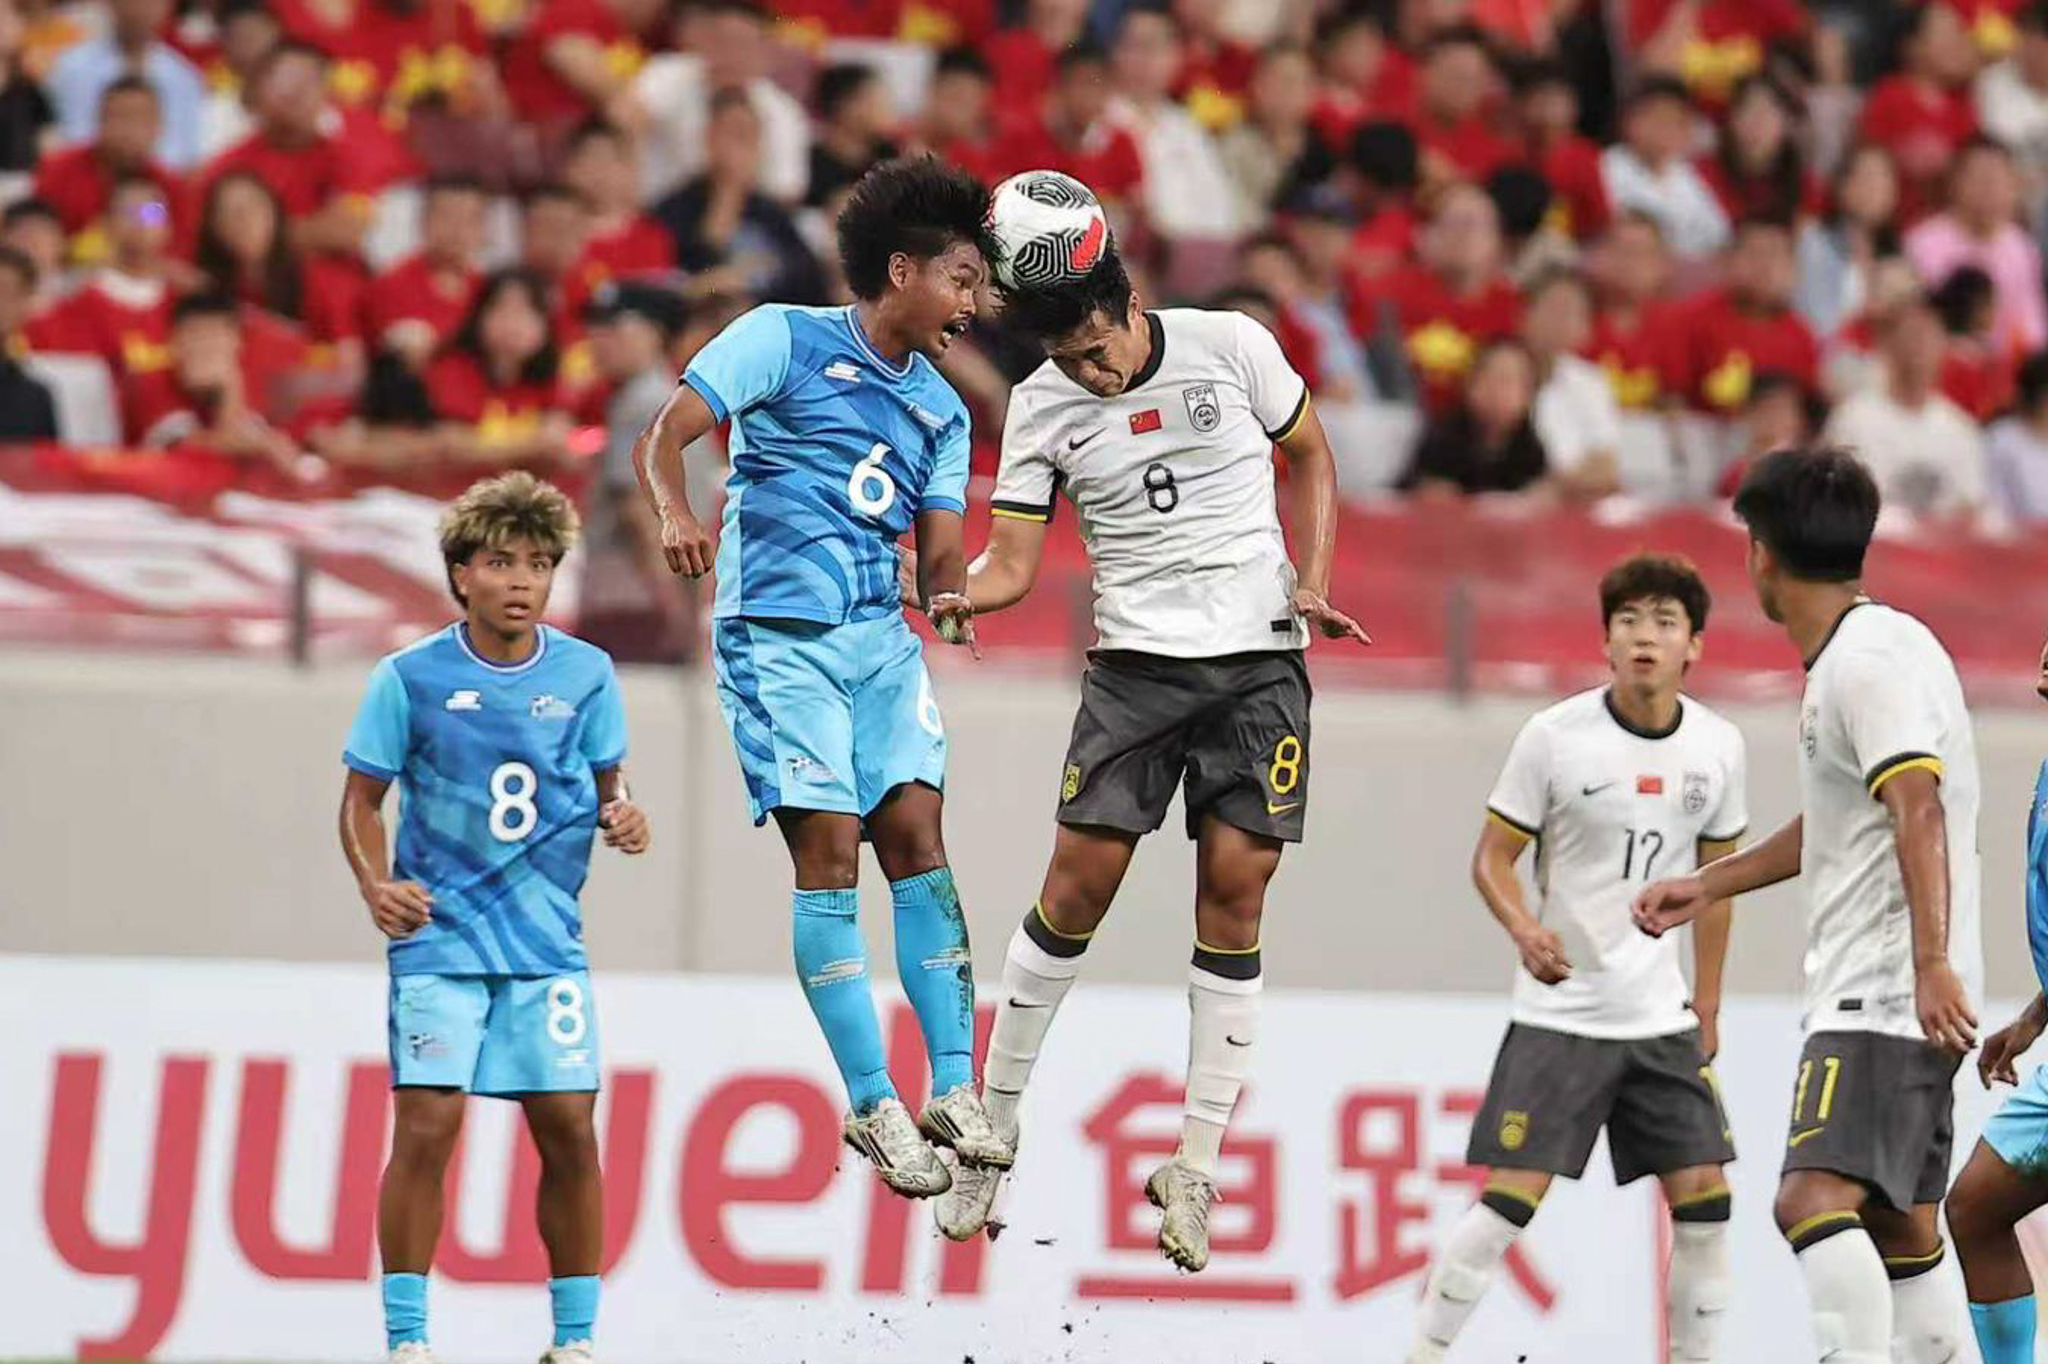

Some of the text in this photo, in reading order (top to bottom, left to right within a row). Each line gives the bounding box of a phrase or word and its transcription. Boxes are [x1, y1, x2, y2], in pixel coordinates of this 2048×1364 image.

[848, 442, 896, 516] 6
[1143, 462, 1178, 513] 8
[1268, 735, 1302, 795] 8
[489, 762, 538, 842] 8
[547, 978, 586, 1044] 8
[1794, 1056, 1840, 1121] 11
